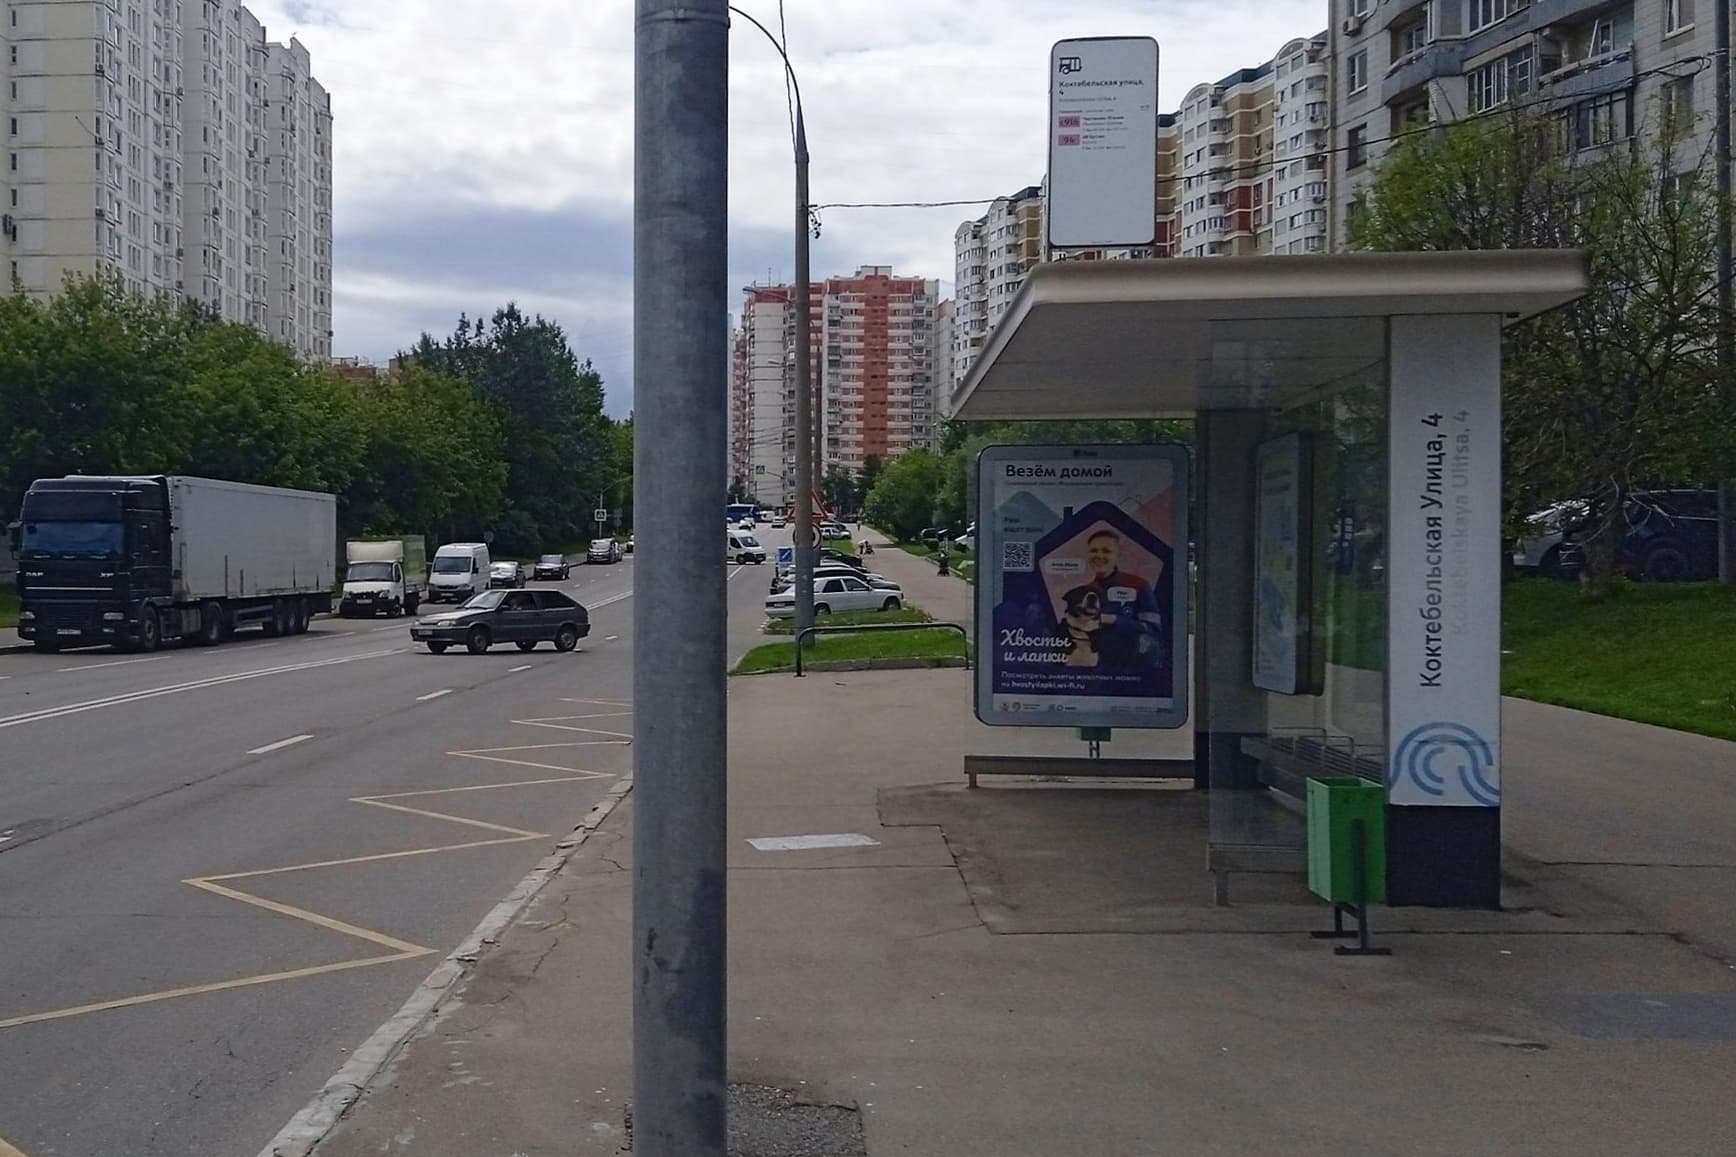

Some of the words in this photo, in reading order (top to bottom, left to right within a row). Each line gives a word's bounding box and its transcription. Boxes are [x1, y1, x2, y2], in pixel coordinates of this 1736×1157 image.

[1420, 412, 1443, 428] 4
[1453, 409, 1471, 423] 4
[1452, 428, 1472, 488] Ulitsa,
[1006, 464, 1056, 478] Везём
[1060, 464, 1113, 479] домой
[1420, 433, 1446, 509] Улица,
[1420, 515, 1442, 687] Коктебельская
[1000, 628, 1072, 648] Хвосты
[1004, 652, 1016, 662] и
[1017, 652, 1069, 663] лапки
